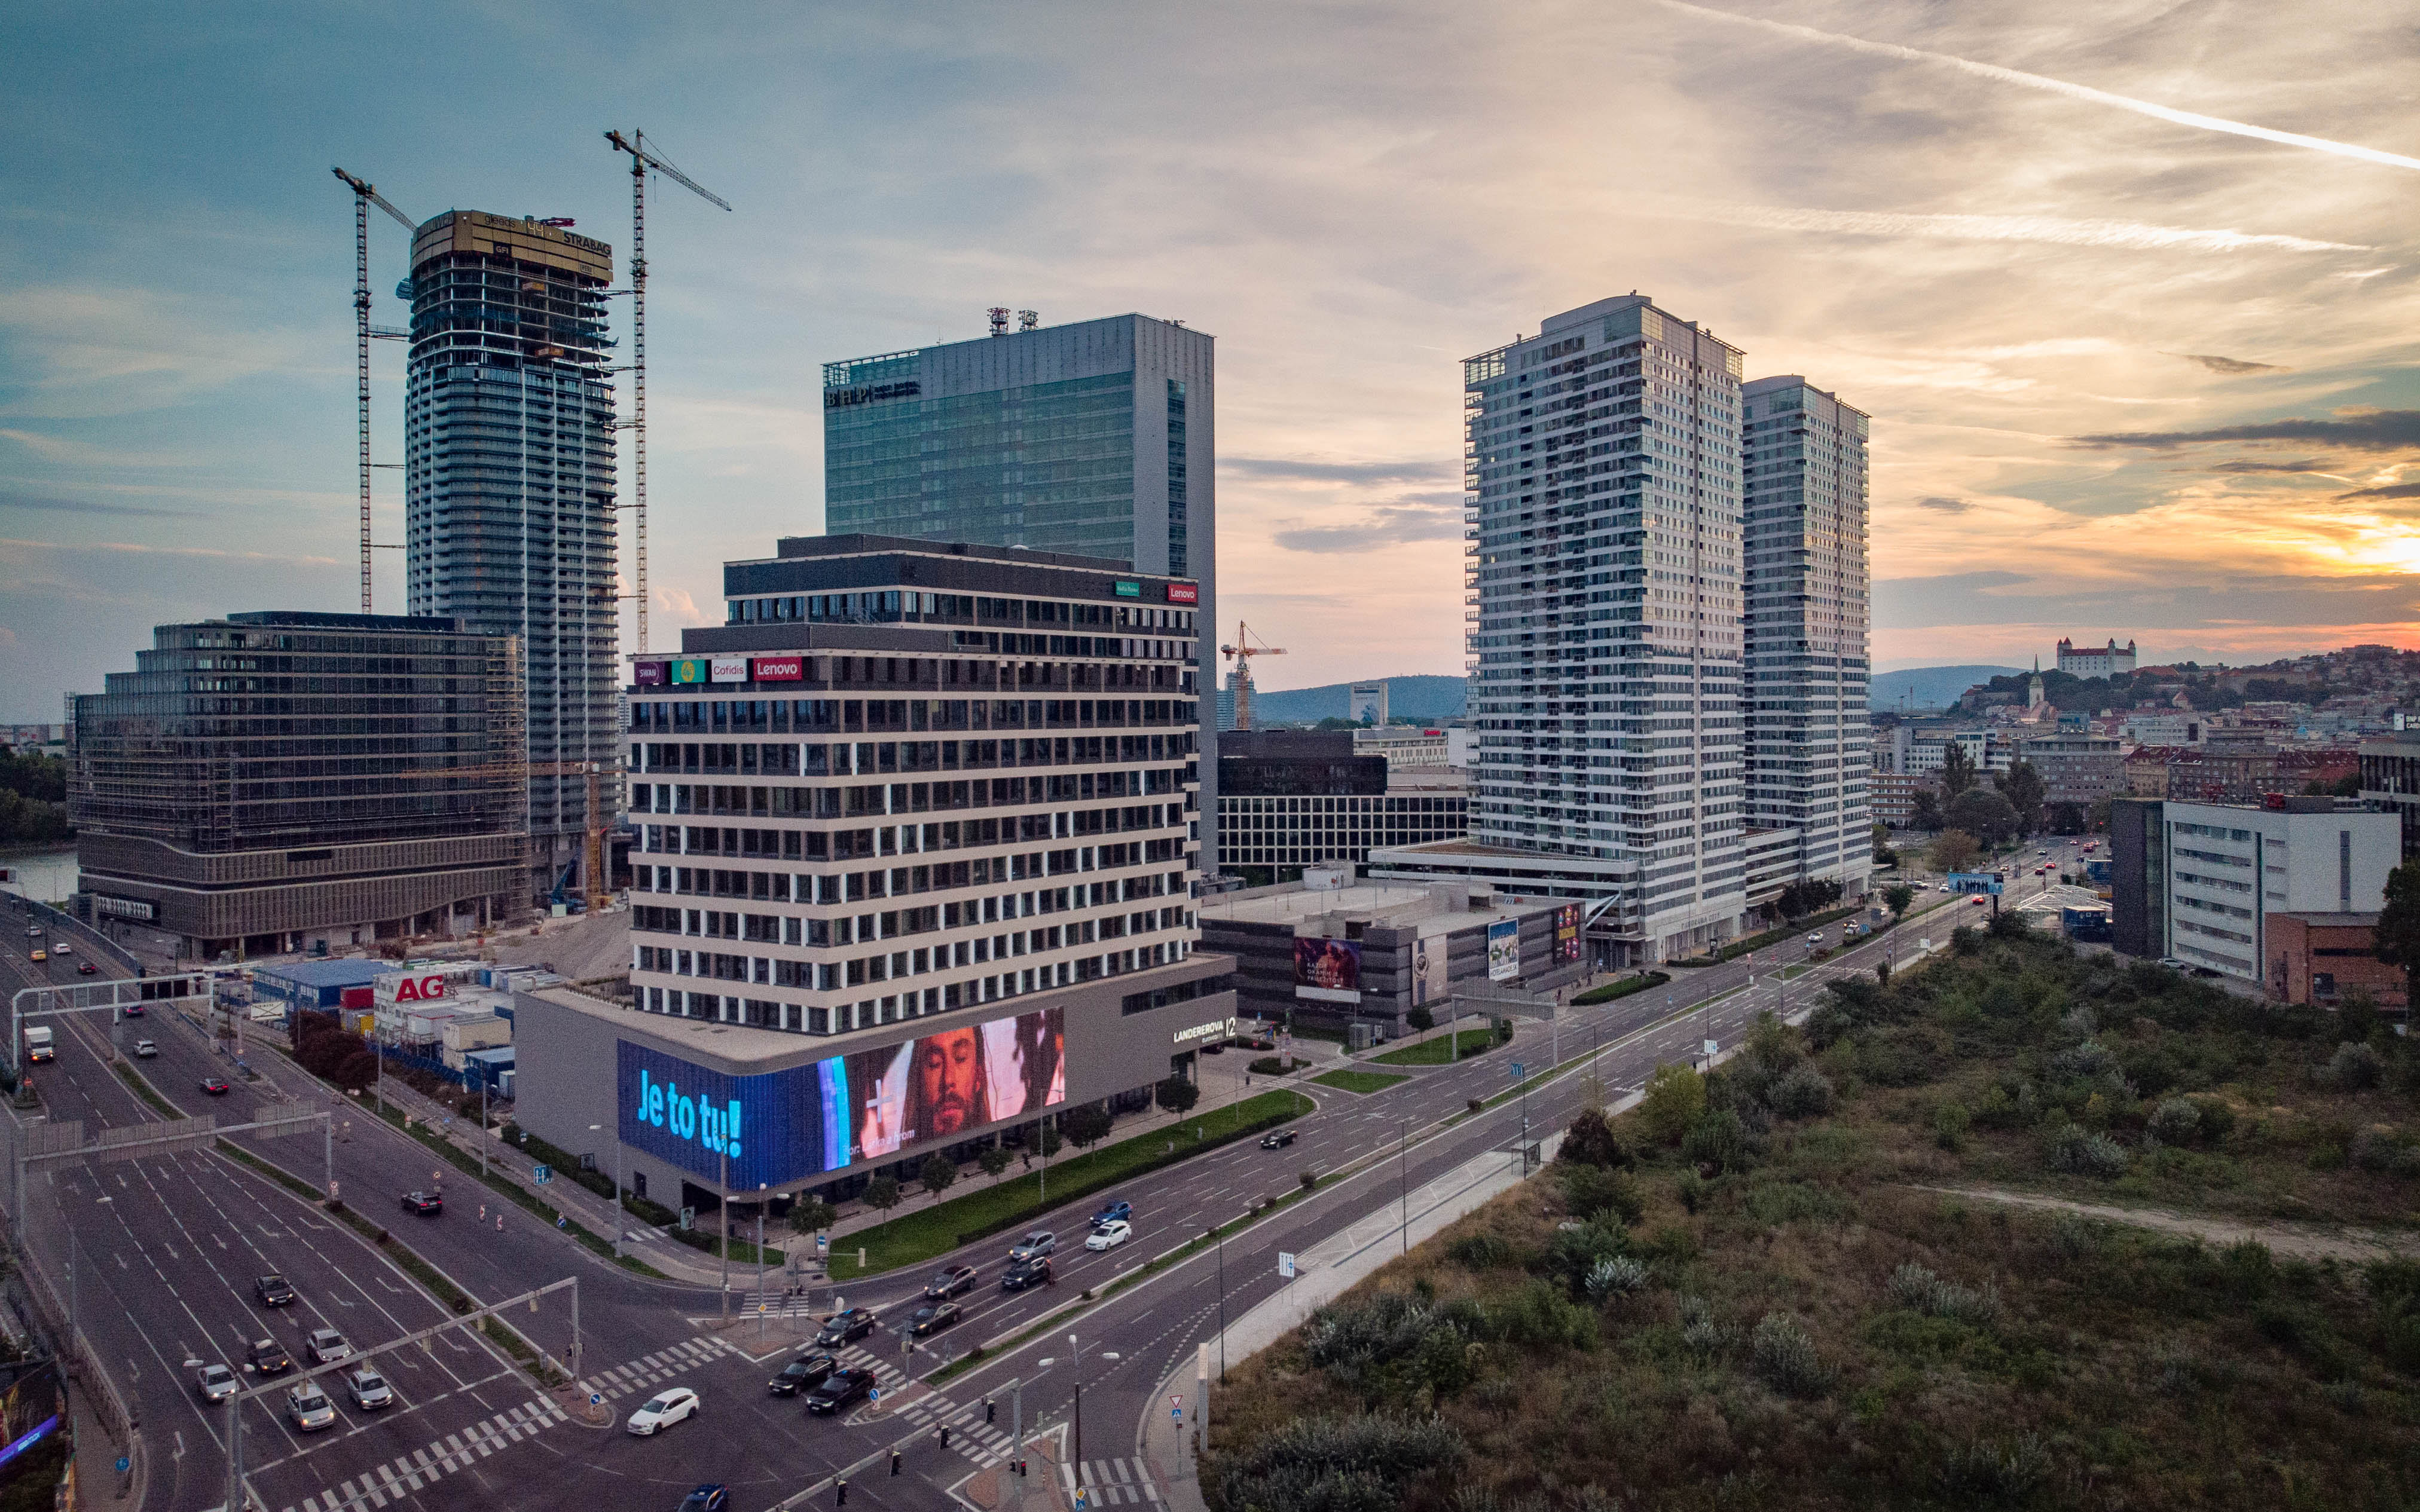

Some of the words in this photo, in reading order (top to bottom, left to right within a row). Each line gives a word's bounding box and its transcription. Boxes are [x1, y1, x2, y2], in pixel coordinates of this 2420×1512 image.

[484, 215, 516, 228] gleeds
[527, 222, 544, 237] 44
[496, 246, 509, 254] GFI
[564, 232, 611, 255] STRABAG
[1171, 588, 1194, 598] Lenovo
[640, 668, 656, 678] SWAN
[713, 664, 744, 675] Cofidis
[757, 662, 798, 676] Lenovo
[396, 975, 444, 1002] AG
[1174, 1020, 1224, 1043] LANDEREROVA
[1226, 1017, 1236, 1037] 12
[638, 1069, 664, 1128] Je
[667, 1082, 695, 1140] to
[699, 1093, 741, 1159] tu!
